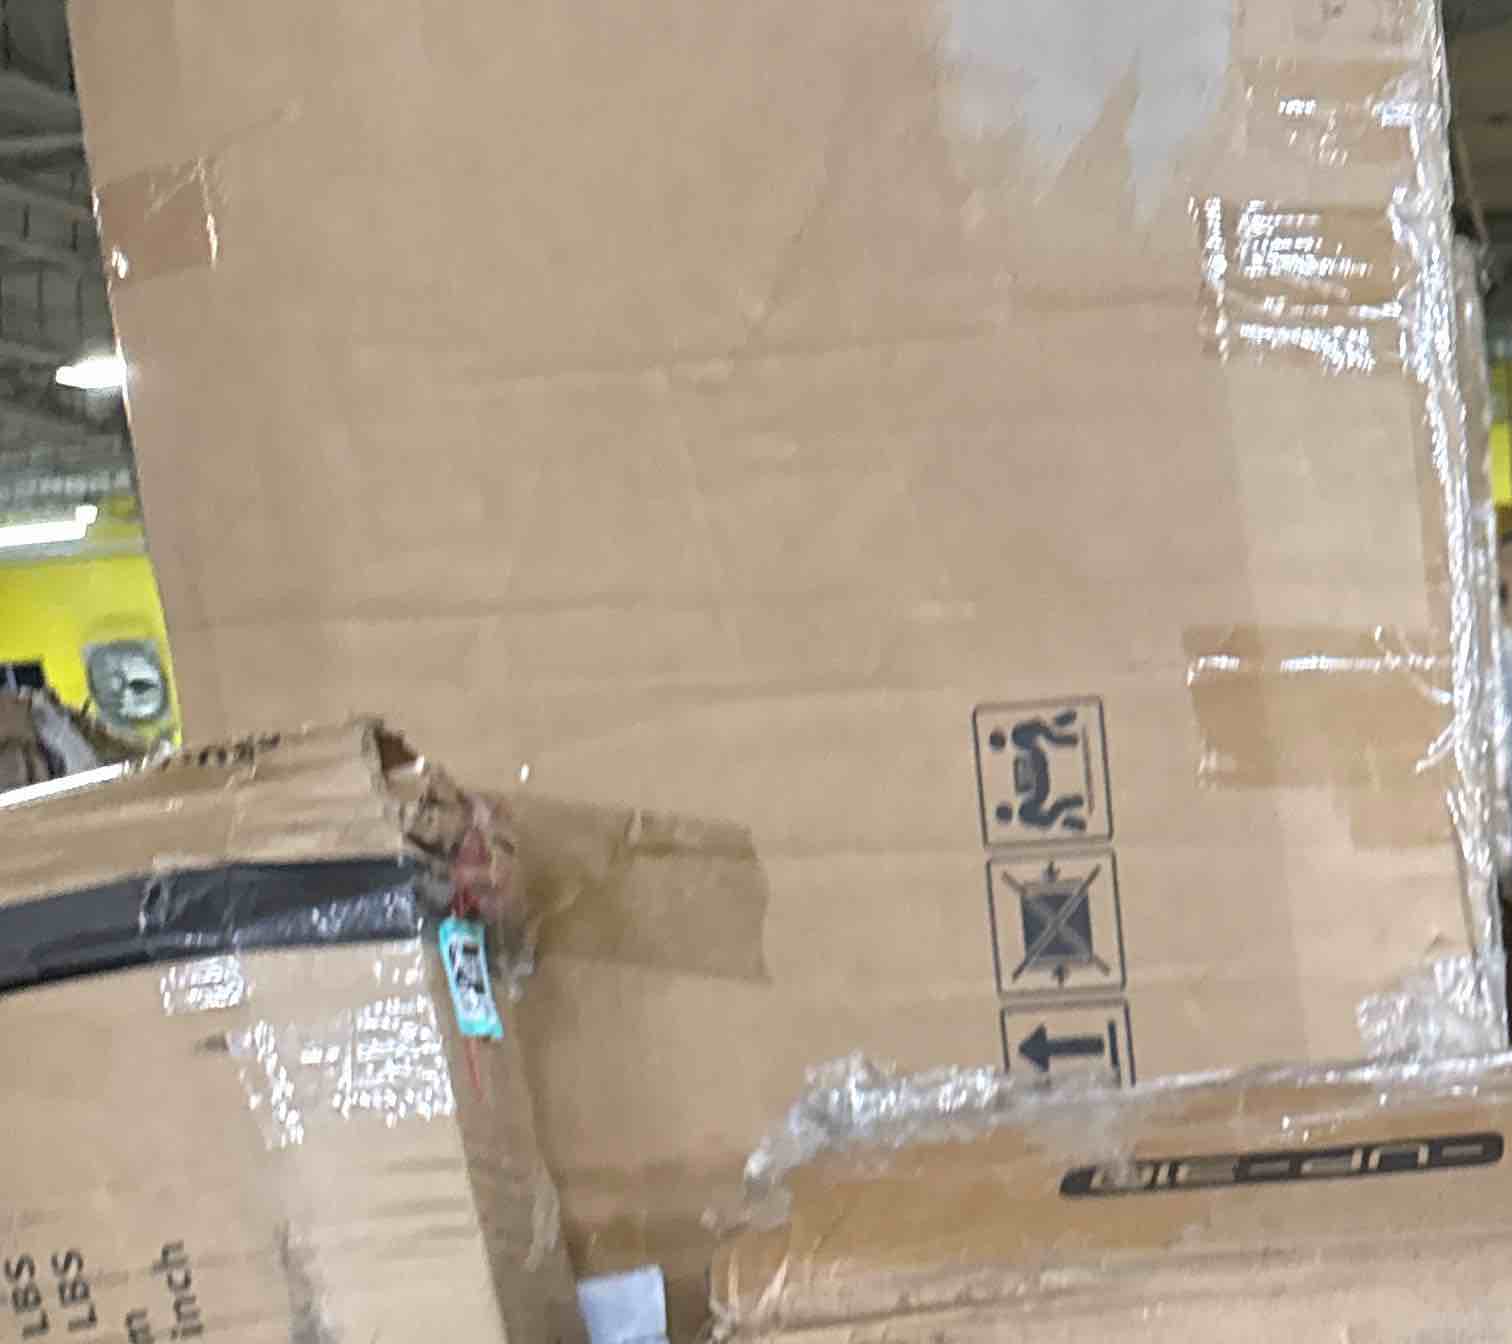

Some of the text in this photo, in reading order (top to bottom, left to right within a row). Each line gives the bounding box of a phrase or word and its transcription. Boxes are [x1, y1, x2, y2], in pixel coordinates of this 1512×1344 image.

[5, 1254, 49, 1340] LBS
[52, 1249, 97, 1332] LBS
[152, 1240, 203, 1341] inch
